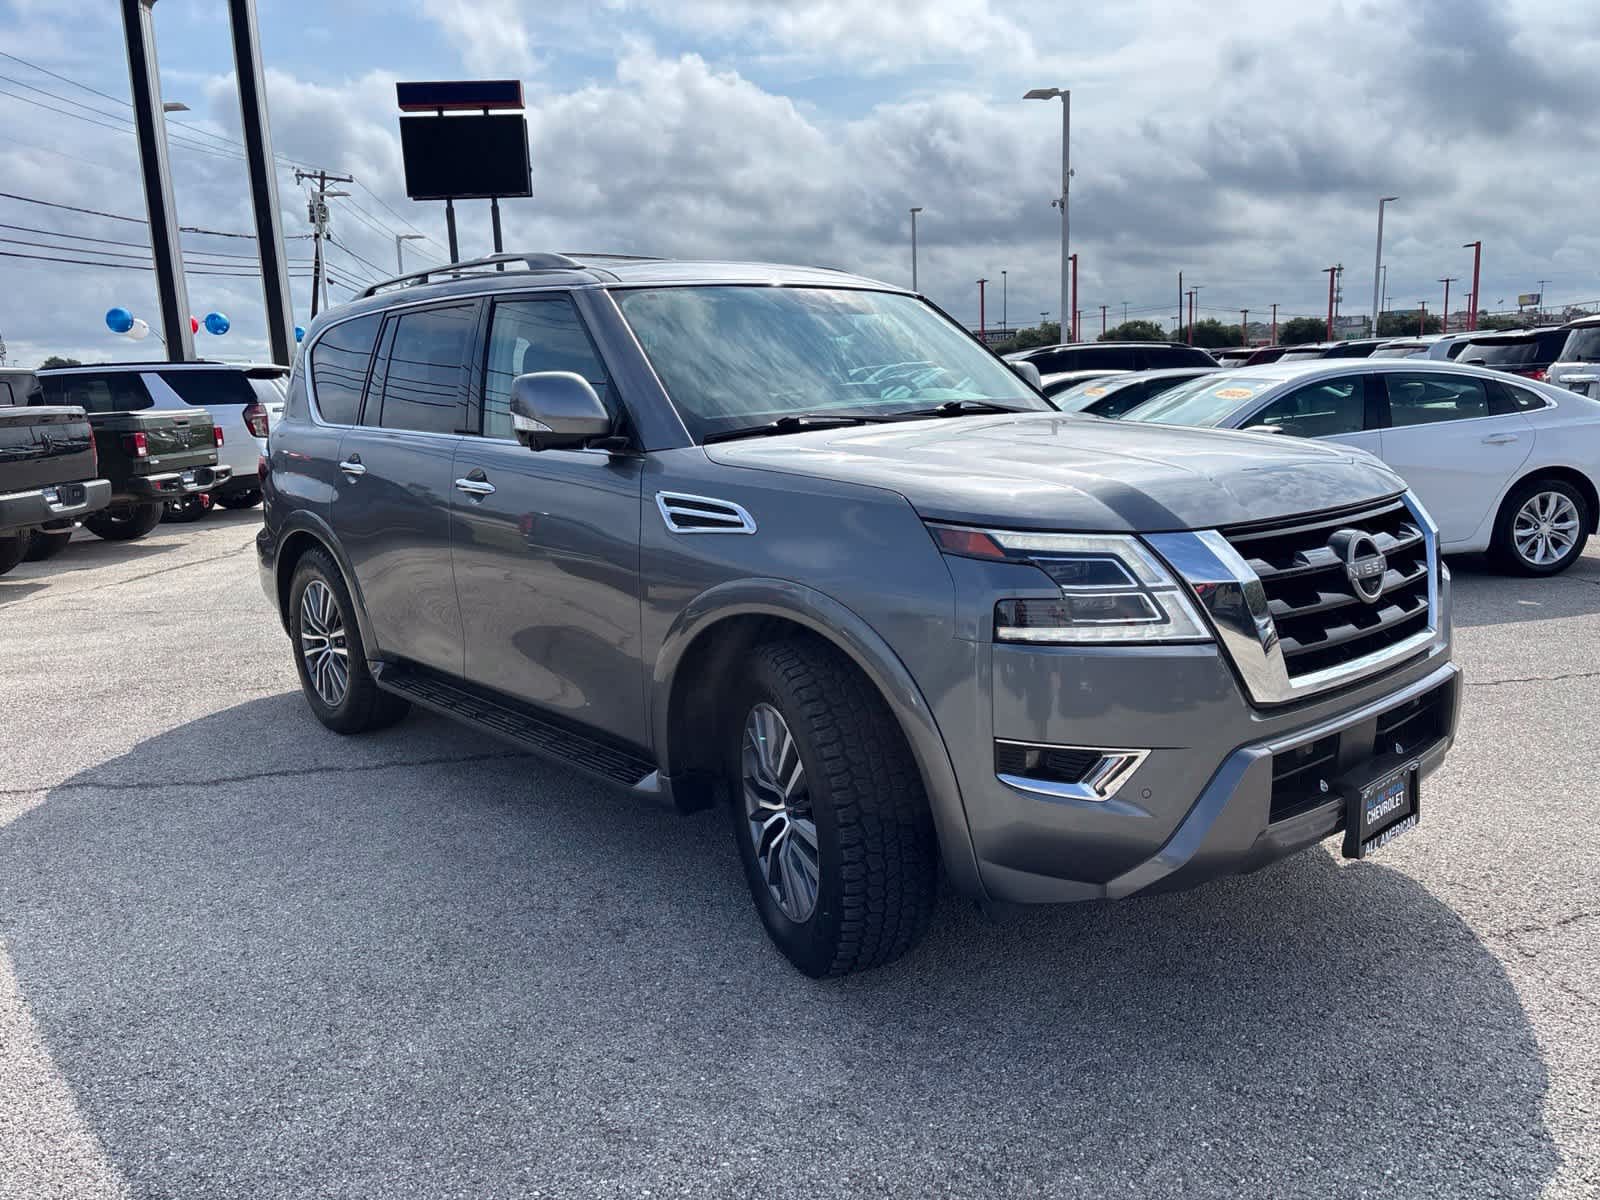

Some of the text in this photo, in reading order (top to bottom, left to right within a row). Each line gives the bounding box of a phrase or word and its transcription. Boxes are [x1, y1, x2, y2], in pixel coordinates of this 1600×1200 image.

[1366, 791, 1405, 825] CHEVROLET
[1365, 814, 1417, 854] ALL AMERICAN
